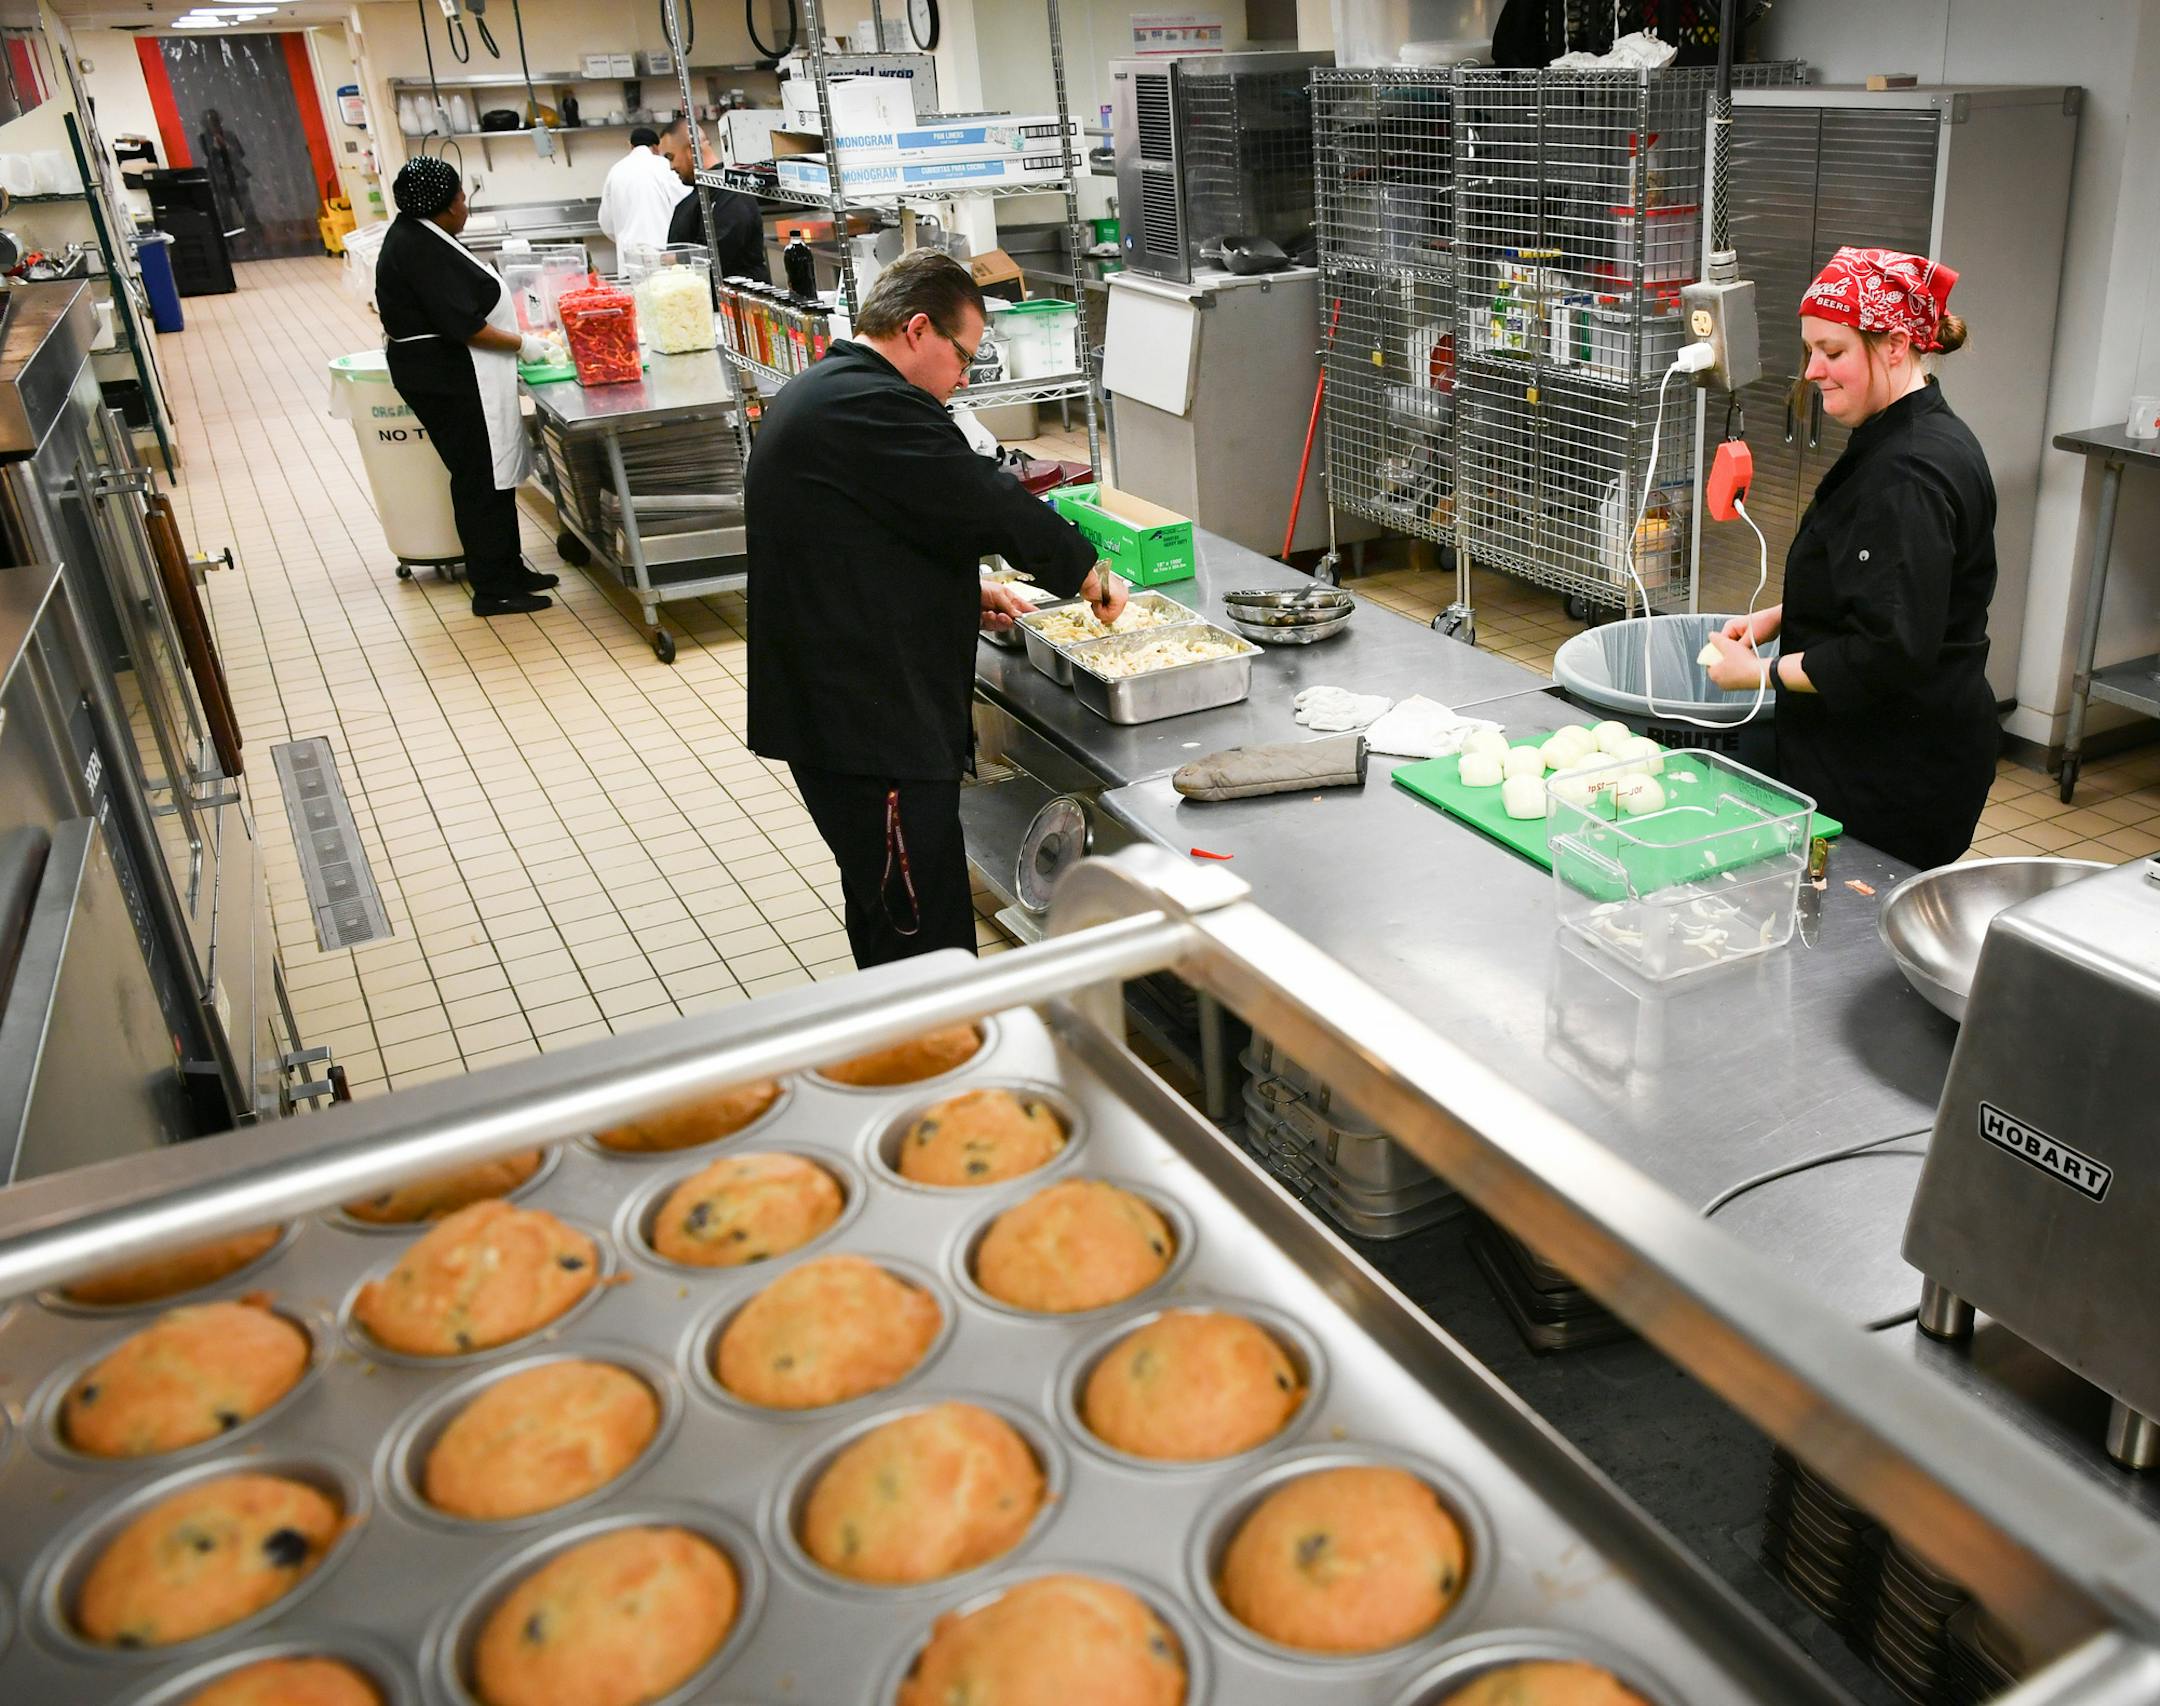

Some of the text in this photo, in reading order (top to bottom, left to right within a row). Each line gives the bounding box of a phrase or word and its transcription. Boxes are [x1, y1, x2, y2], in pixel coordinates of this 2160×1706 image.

[835, 134, 893, 149] MONOGRAM
[841, 167, 898, 183] MONOGRAM
[1816, 297, 1850, 313] BEERS
[378, 429, 408, 441] NO
[1647, 727, 1740, 751] BRUTE
[1987, 1115, 2102, 1188] HOBART
